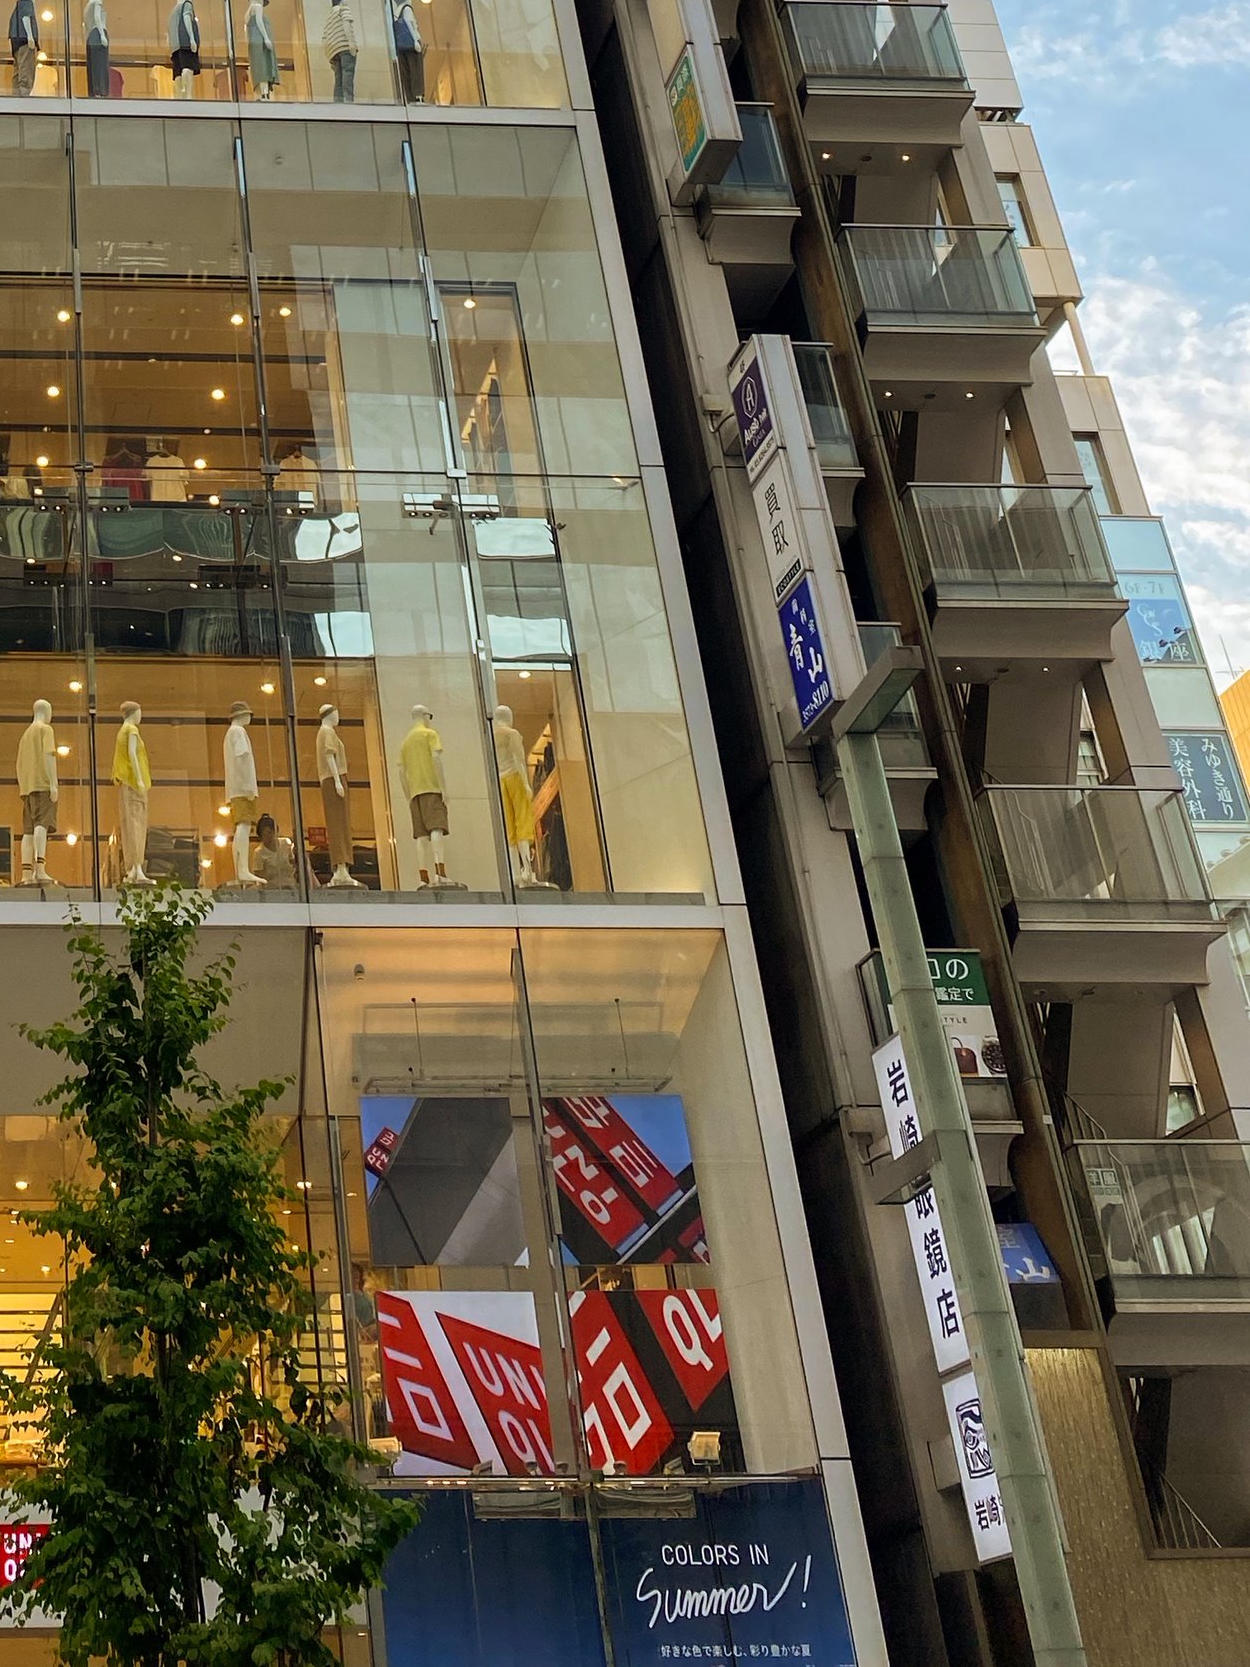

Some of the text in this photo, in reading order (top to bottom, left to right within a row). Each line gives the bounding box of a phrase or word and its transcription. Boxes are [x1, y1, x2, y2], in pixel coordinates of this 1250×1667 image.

[764, 482, 789, 556] 買取
[789, 623, 824, 684] 青山
[1168, 737, 1207, 820] 美容外科
[1201, 738, 1234, 820] みゆき通り
[935, 987, 975, 1002] 鑑定で
[941, 1016, 968, 1024] TYLE
[661, 1544, 769, 1565] COLORS IN
